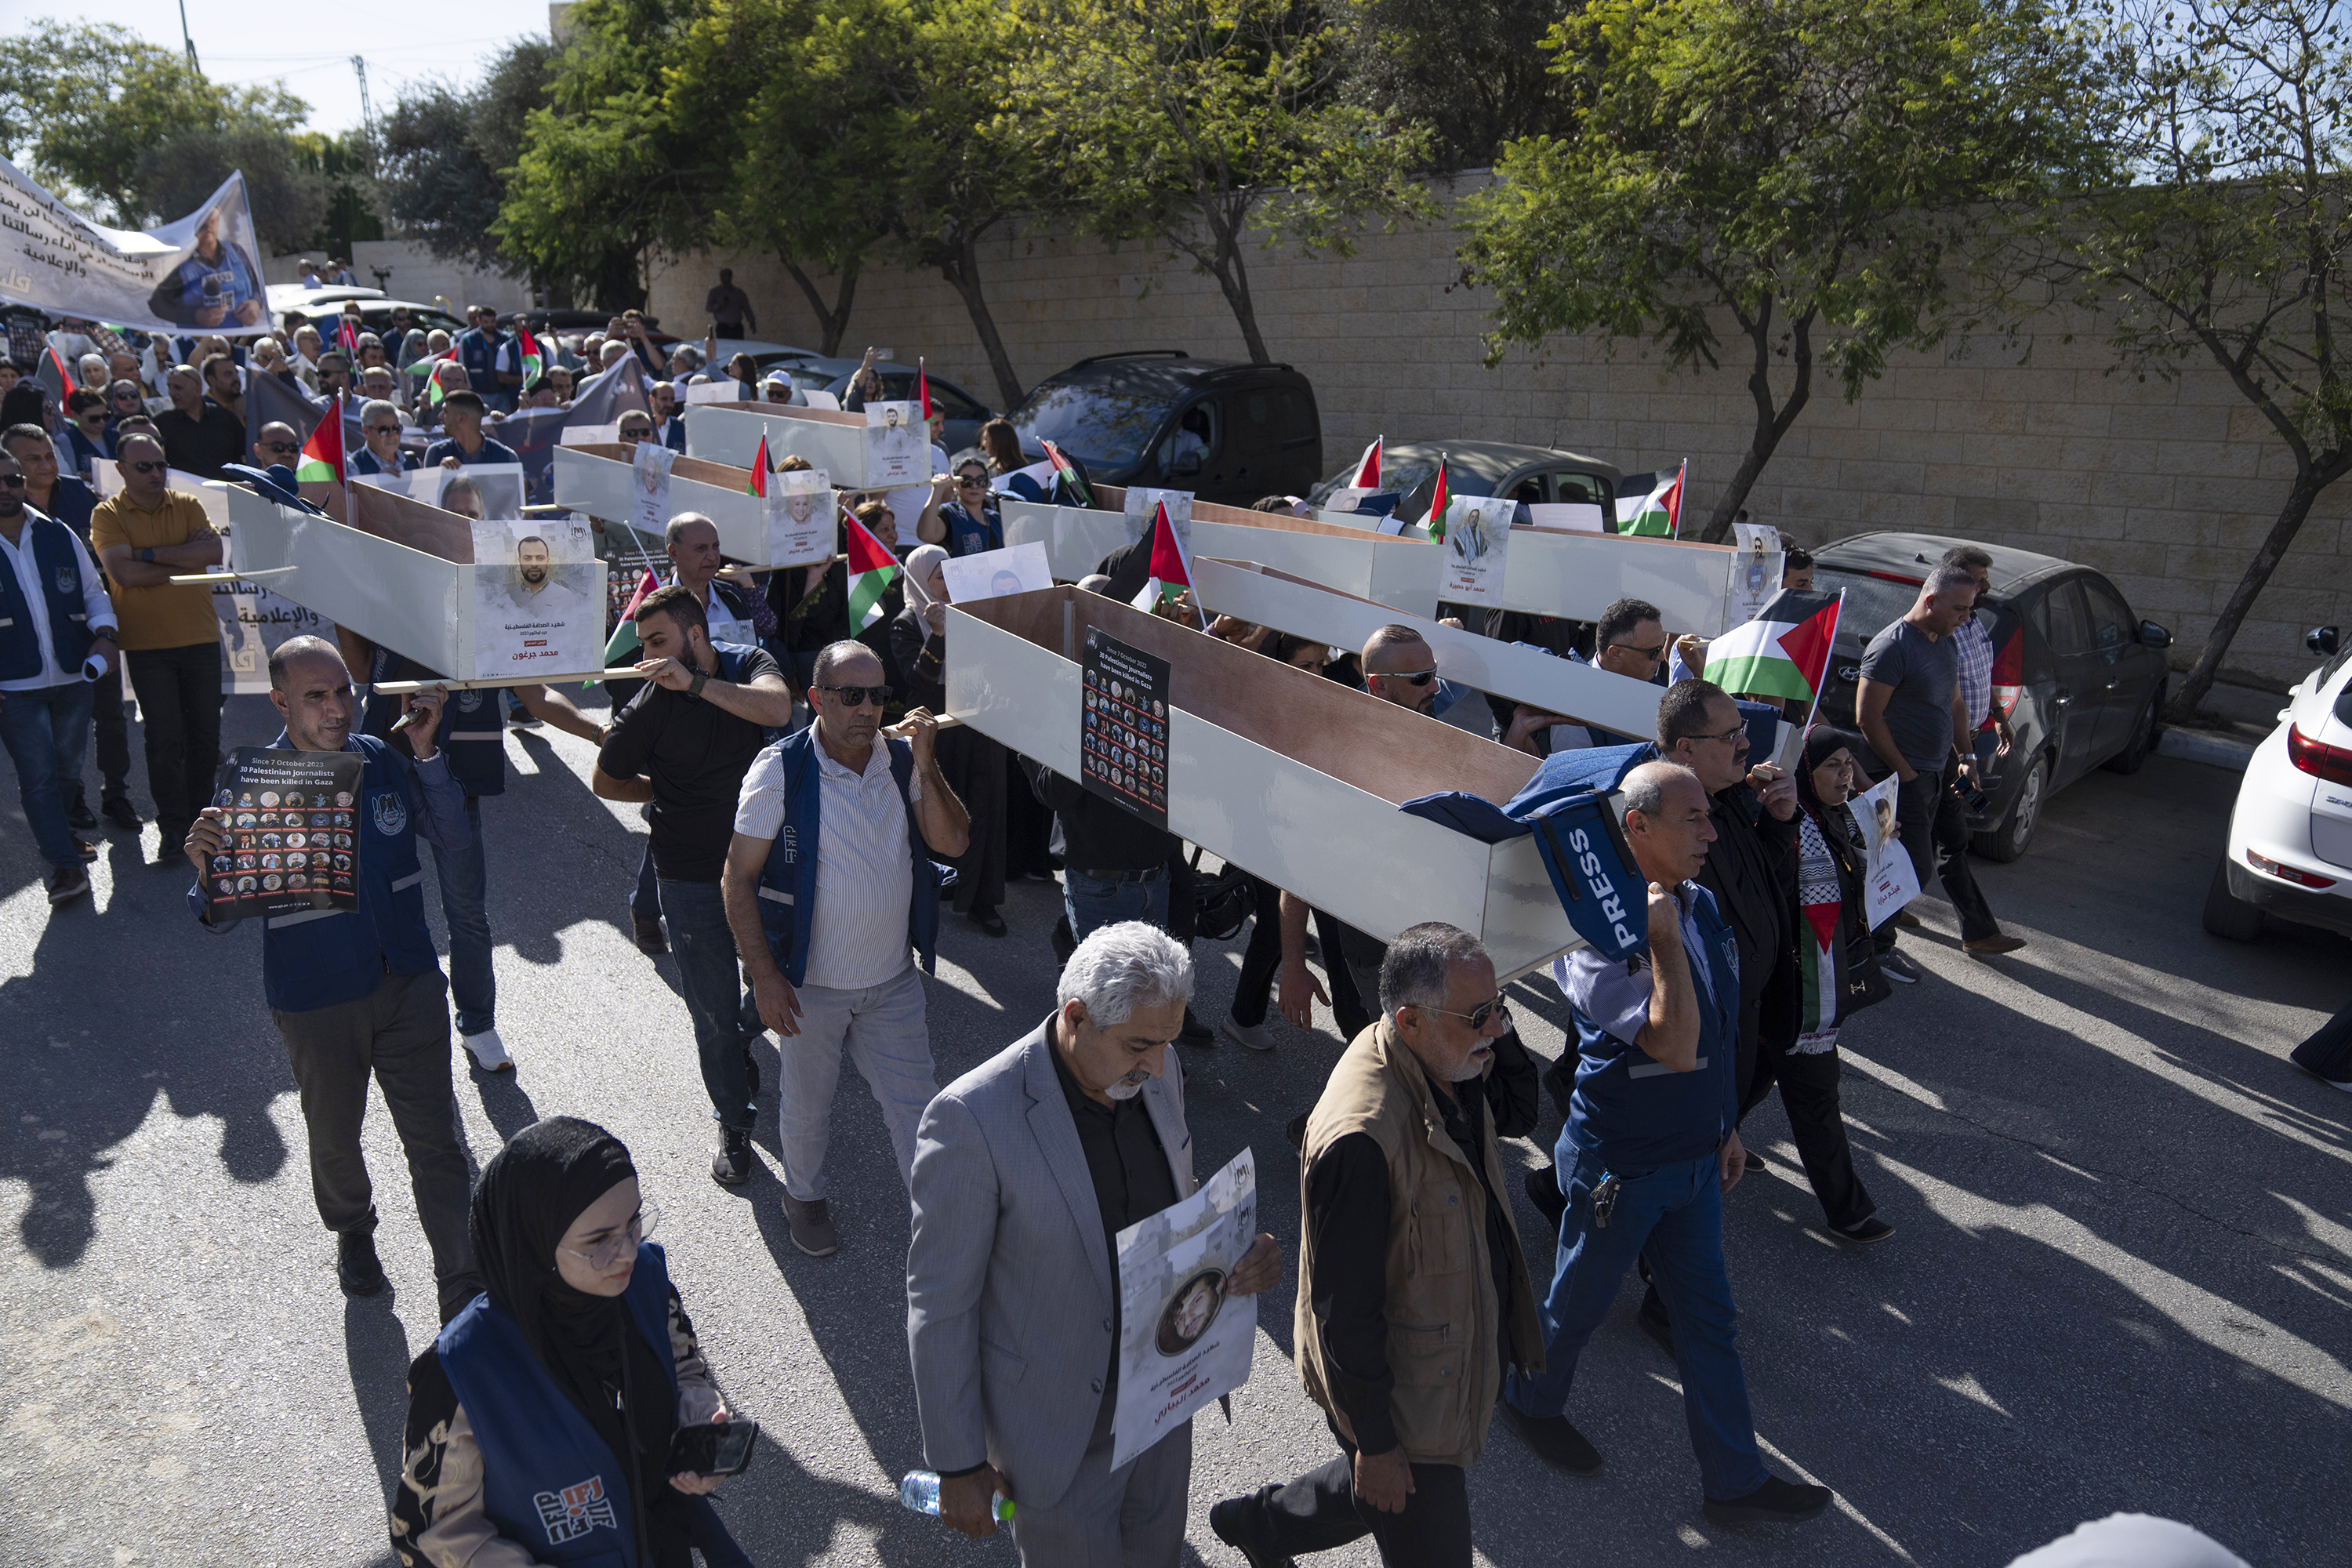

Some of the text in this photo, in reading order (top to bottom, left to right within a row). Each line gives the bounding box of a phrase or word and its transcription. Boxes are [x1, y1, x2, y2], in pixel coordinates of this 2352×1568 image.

[23, 205, 40, 218] لن
[2, 213, 49, 245] رسالتنا
[23, 243, 86, 278] والإعلامية
[78, 249, 93, 263] في
[238, 606, 318, 630] والإعلامية
[512, 651, 537, 660] جرغون
[1106, 646, 1117, 656] Since
[1120, 652, 1136, 665] October
[1137, 660, 1147, 669] 2023
[1100, 661, 1111, 671] have
[1111, 666, 1122, 677] been
[1122, 671, 1134, 682] killed
[1140, 680, 1152, 690] Gaza
[1105, 654, 1129, 670] Palestinian
[1128, 665, 1152, 681] journalists
[249, 767, 291, 775] Palestinian
[1569, 828, 1639, 949] PRESS
[1888, 884, 1900, 899] هيثم
[1202, 1341, 1221, 1356] شهيد
[1189, 1377, 1210, 1397] محمد
[561, 1475, 604, 1507] IFJ
